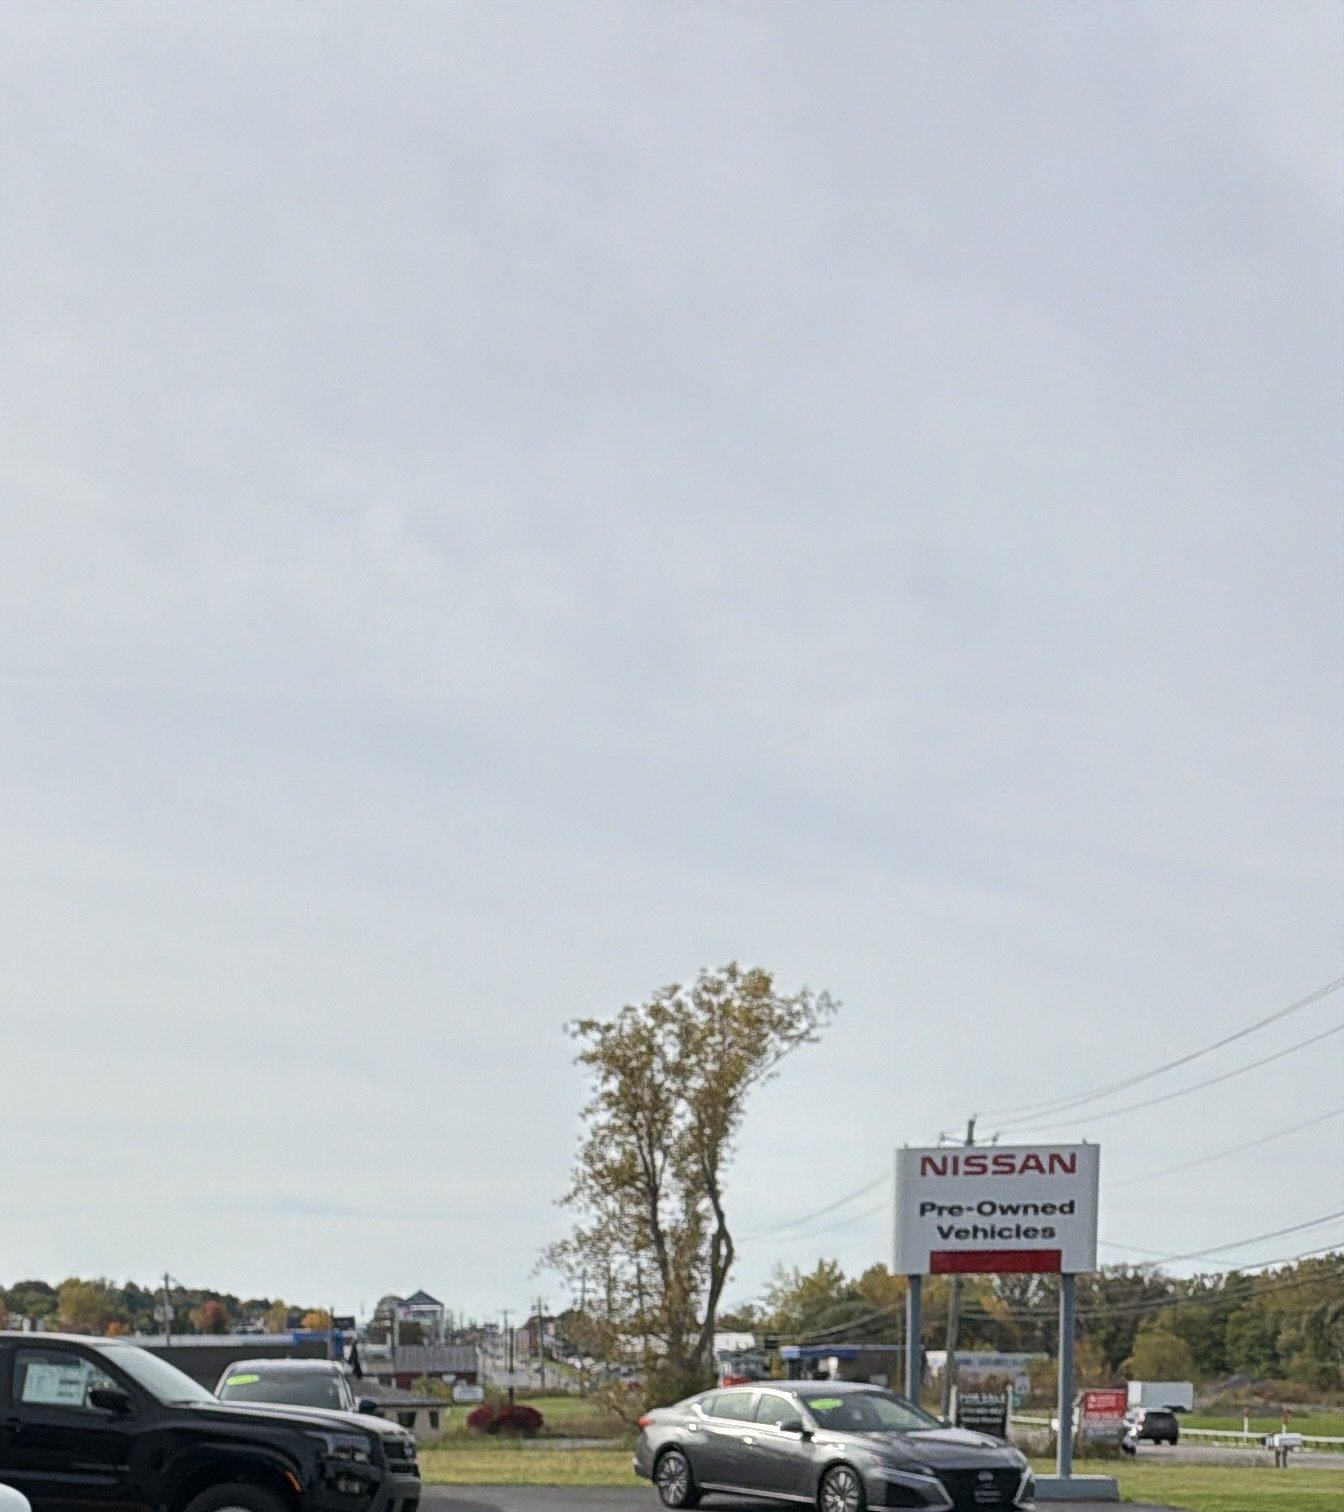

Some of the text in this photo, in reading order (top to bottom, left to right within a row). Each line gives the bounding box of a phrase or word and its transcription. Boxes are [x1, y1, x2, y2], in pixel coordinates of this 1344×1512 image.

[920, 1153, 1077, 1176] NISSAN
[919, 1200, 1076, 1217] Pre-Owned
[936, 1224, 1057, 1240] Vehicles
